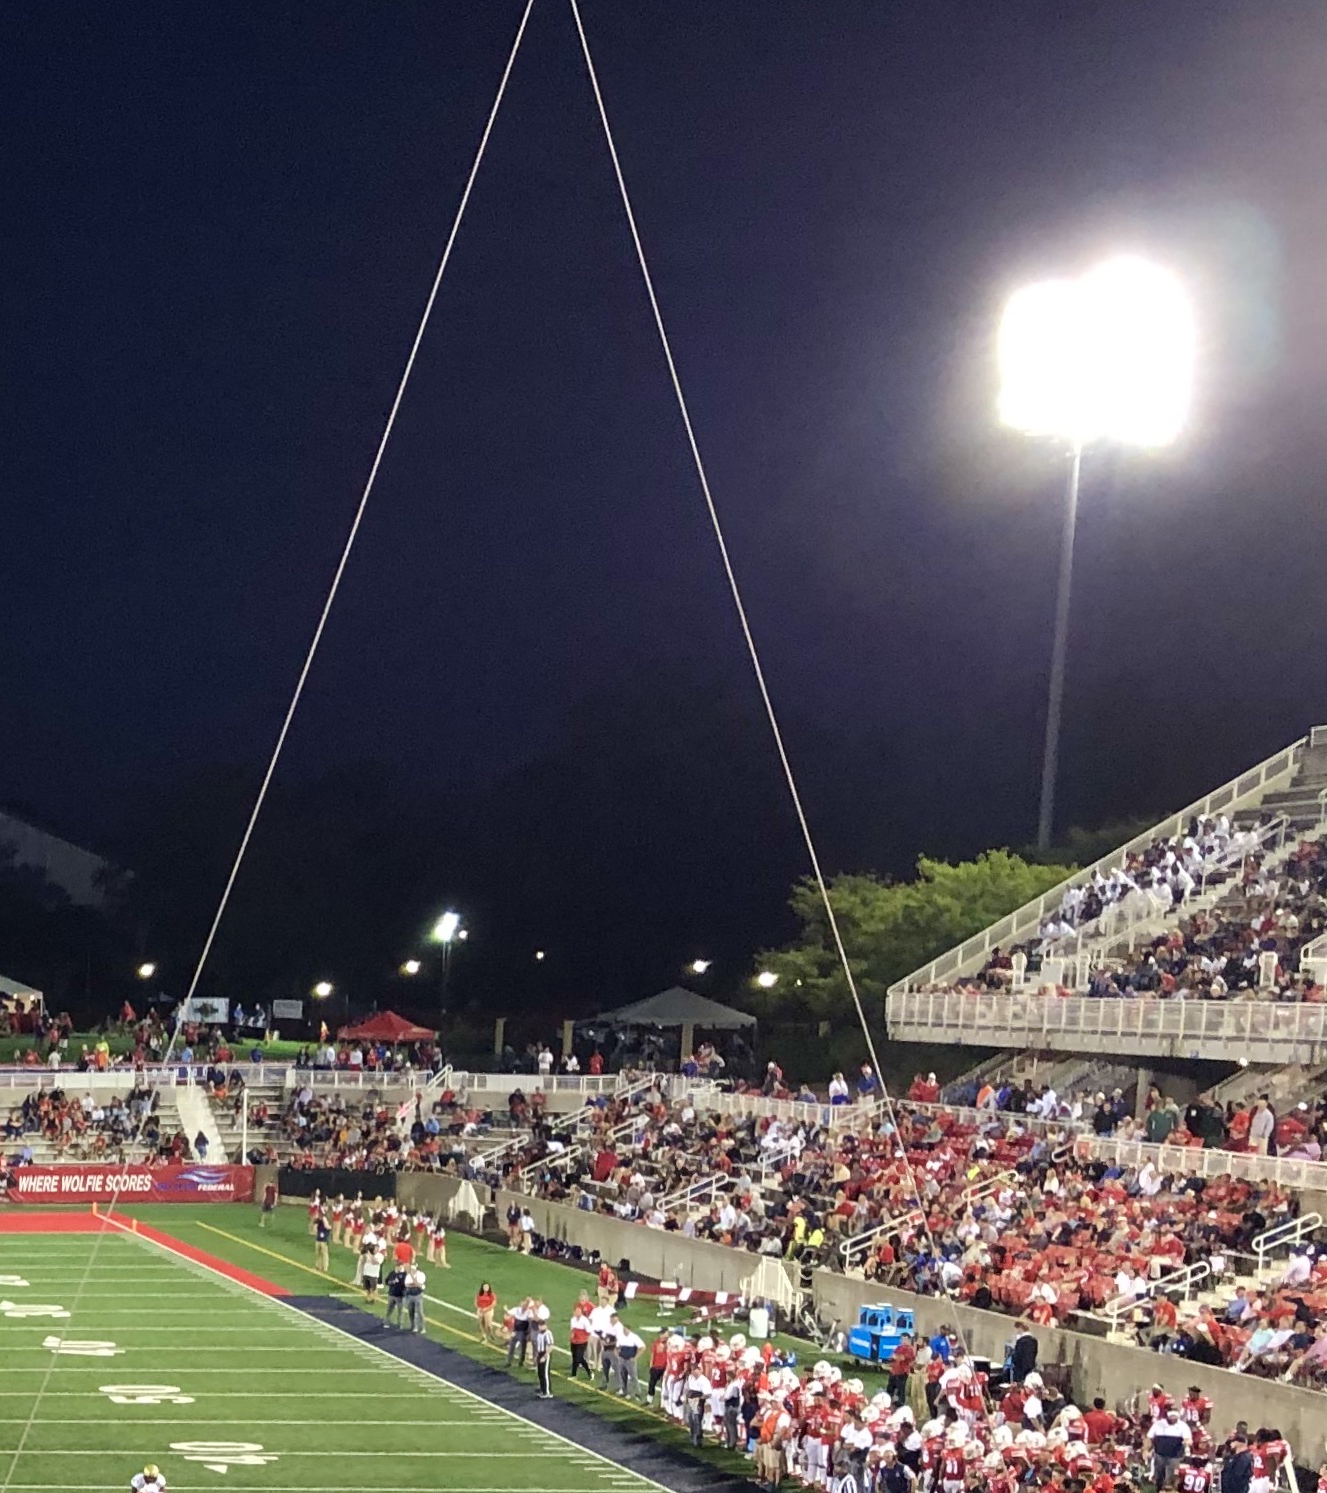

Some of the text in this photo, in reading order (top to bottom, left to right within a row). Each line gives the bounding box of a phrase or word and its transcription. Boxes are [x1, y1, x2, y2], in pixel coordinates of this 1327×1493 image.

[18, 1174, 153, 1193] WHERE WOLFIE SCORES
[198, 1183, 235, 1192] FEDERAL
[1183, 1474, 1206, 1493] 90
